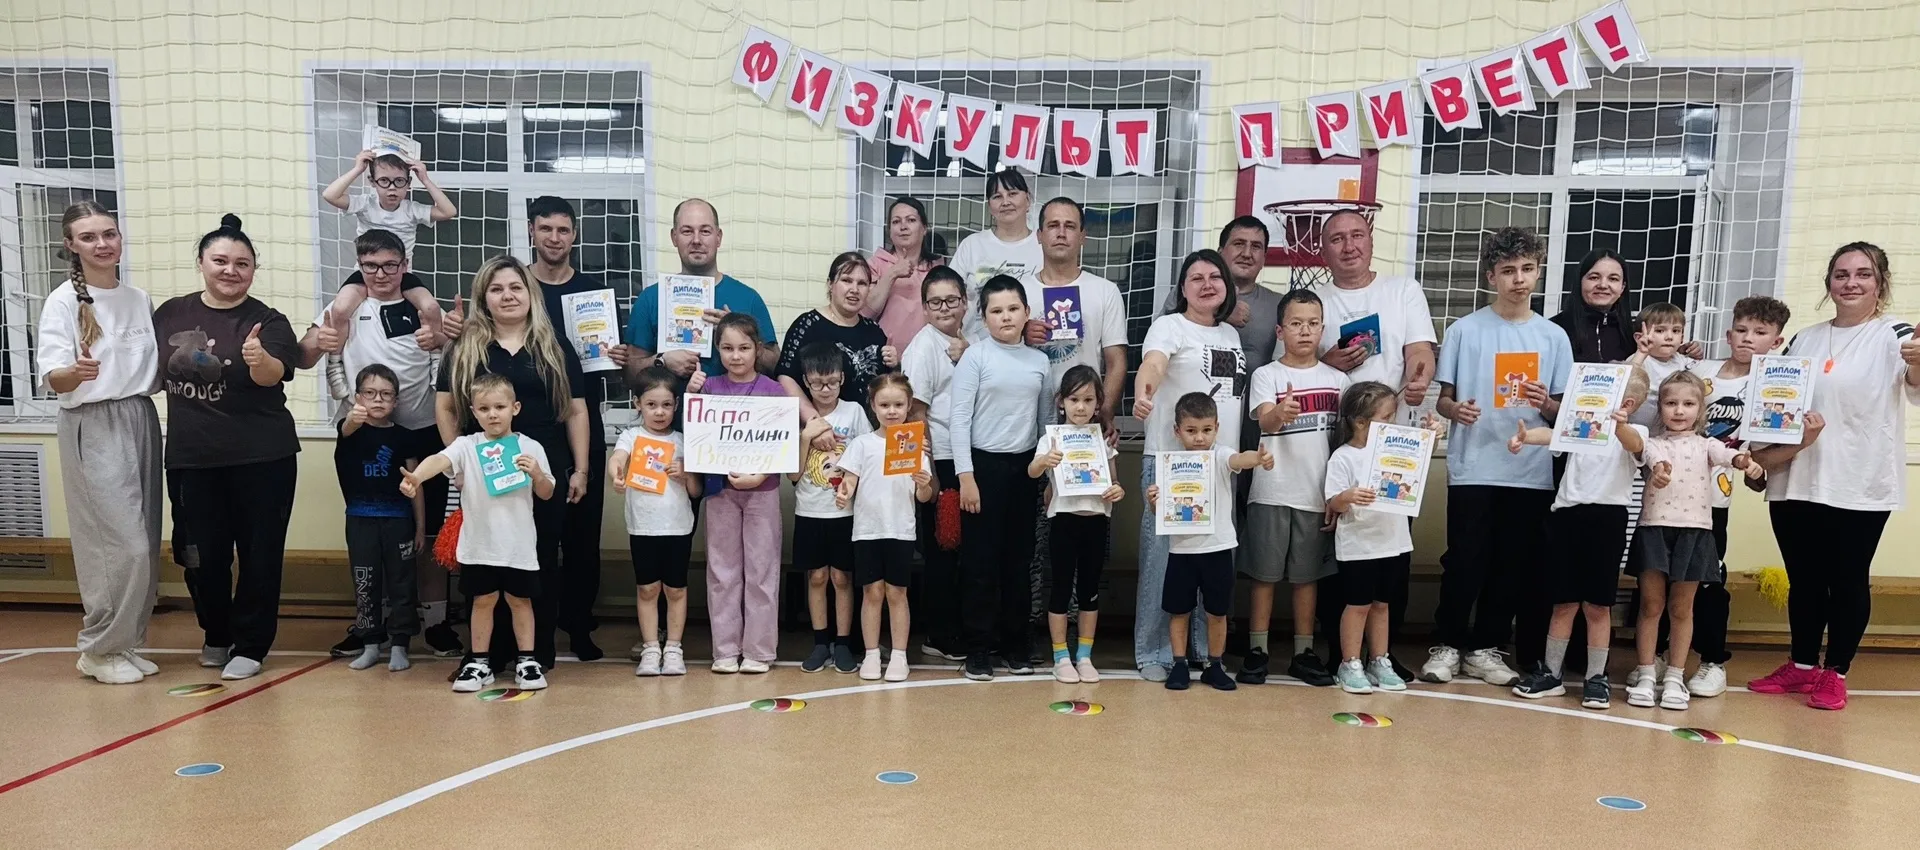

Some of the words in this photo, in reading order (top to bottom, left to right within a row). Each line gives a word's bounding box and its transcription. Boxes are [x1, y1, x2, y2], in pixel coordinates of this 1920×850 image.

[743, 41, 1149, 166] ФИЗКУЛЬТ
[1240, 17, 1630, 160] ПРИВЕТ!
[673, 286, 703, 294] ДИПЛОМ
[576, 301, 604, 312] ДИПЛОМ
[1765, 366, 1801, 376] ДИПЛОМ
[1582, 374, 1615, 384] ДИПЛОМ
[166, 379, 227, 402] THROUGH
[687, 397, 751, 424] Папа
[719, 424, 790, 443] Полина
[1063, 433, 1093, 441] ДИПЛОМ
[1384, 436, 1420, 447] ДИПЛОМ
[1171, 462, 1203, 470] ДИПЛОМ
